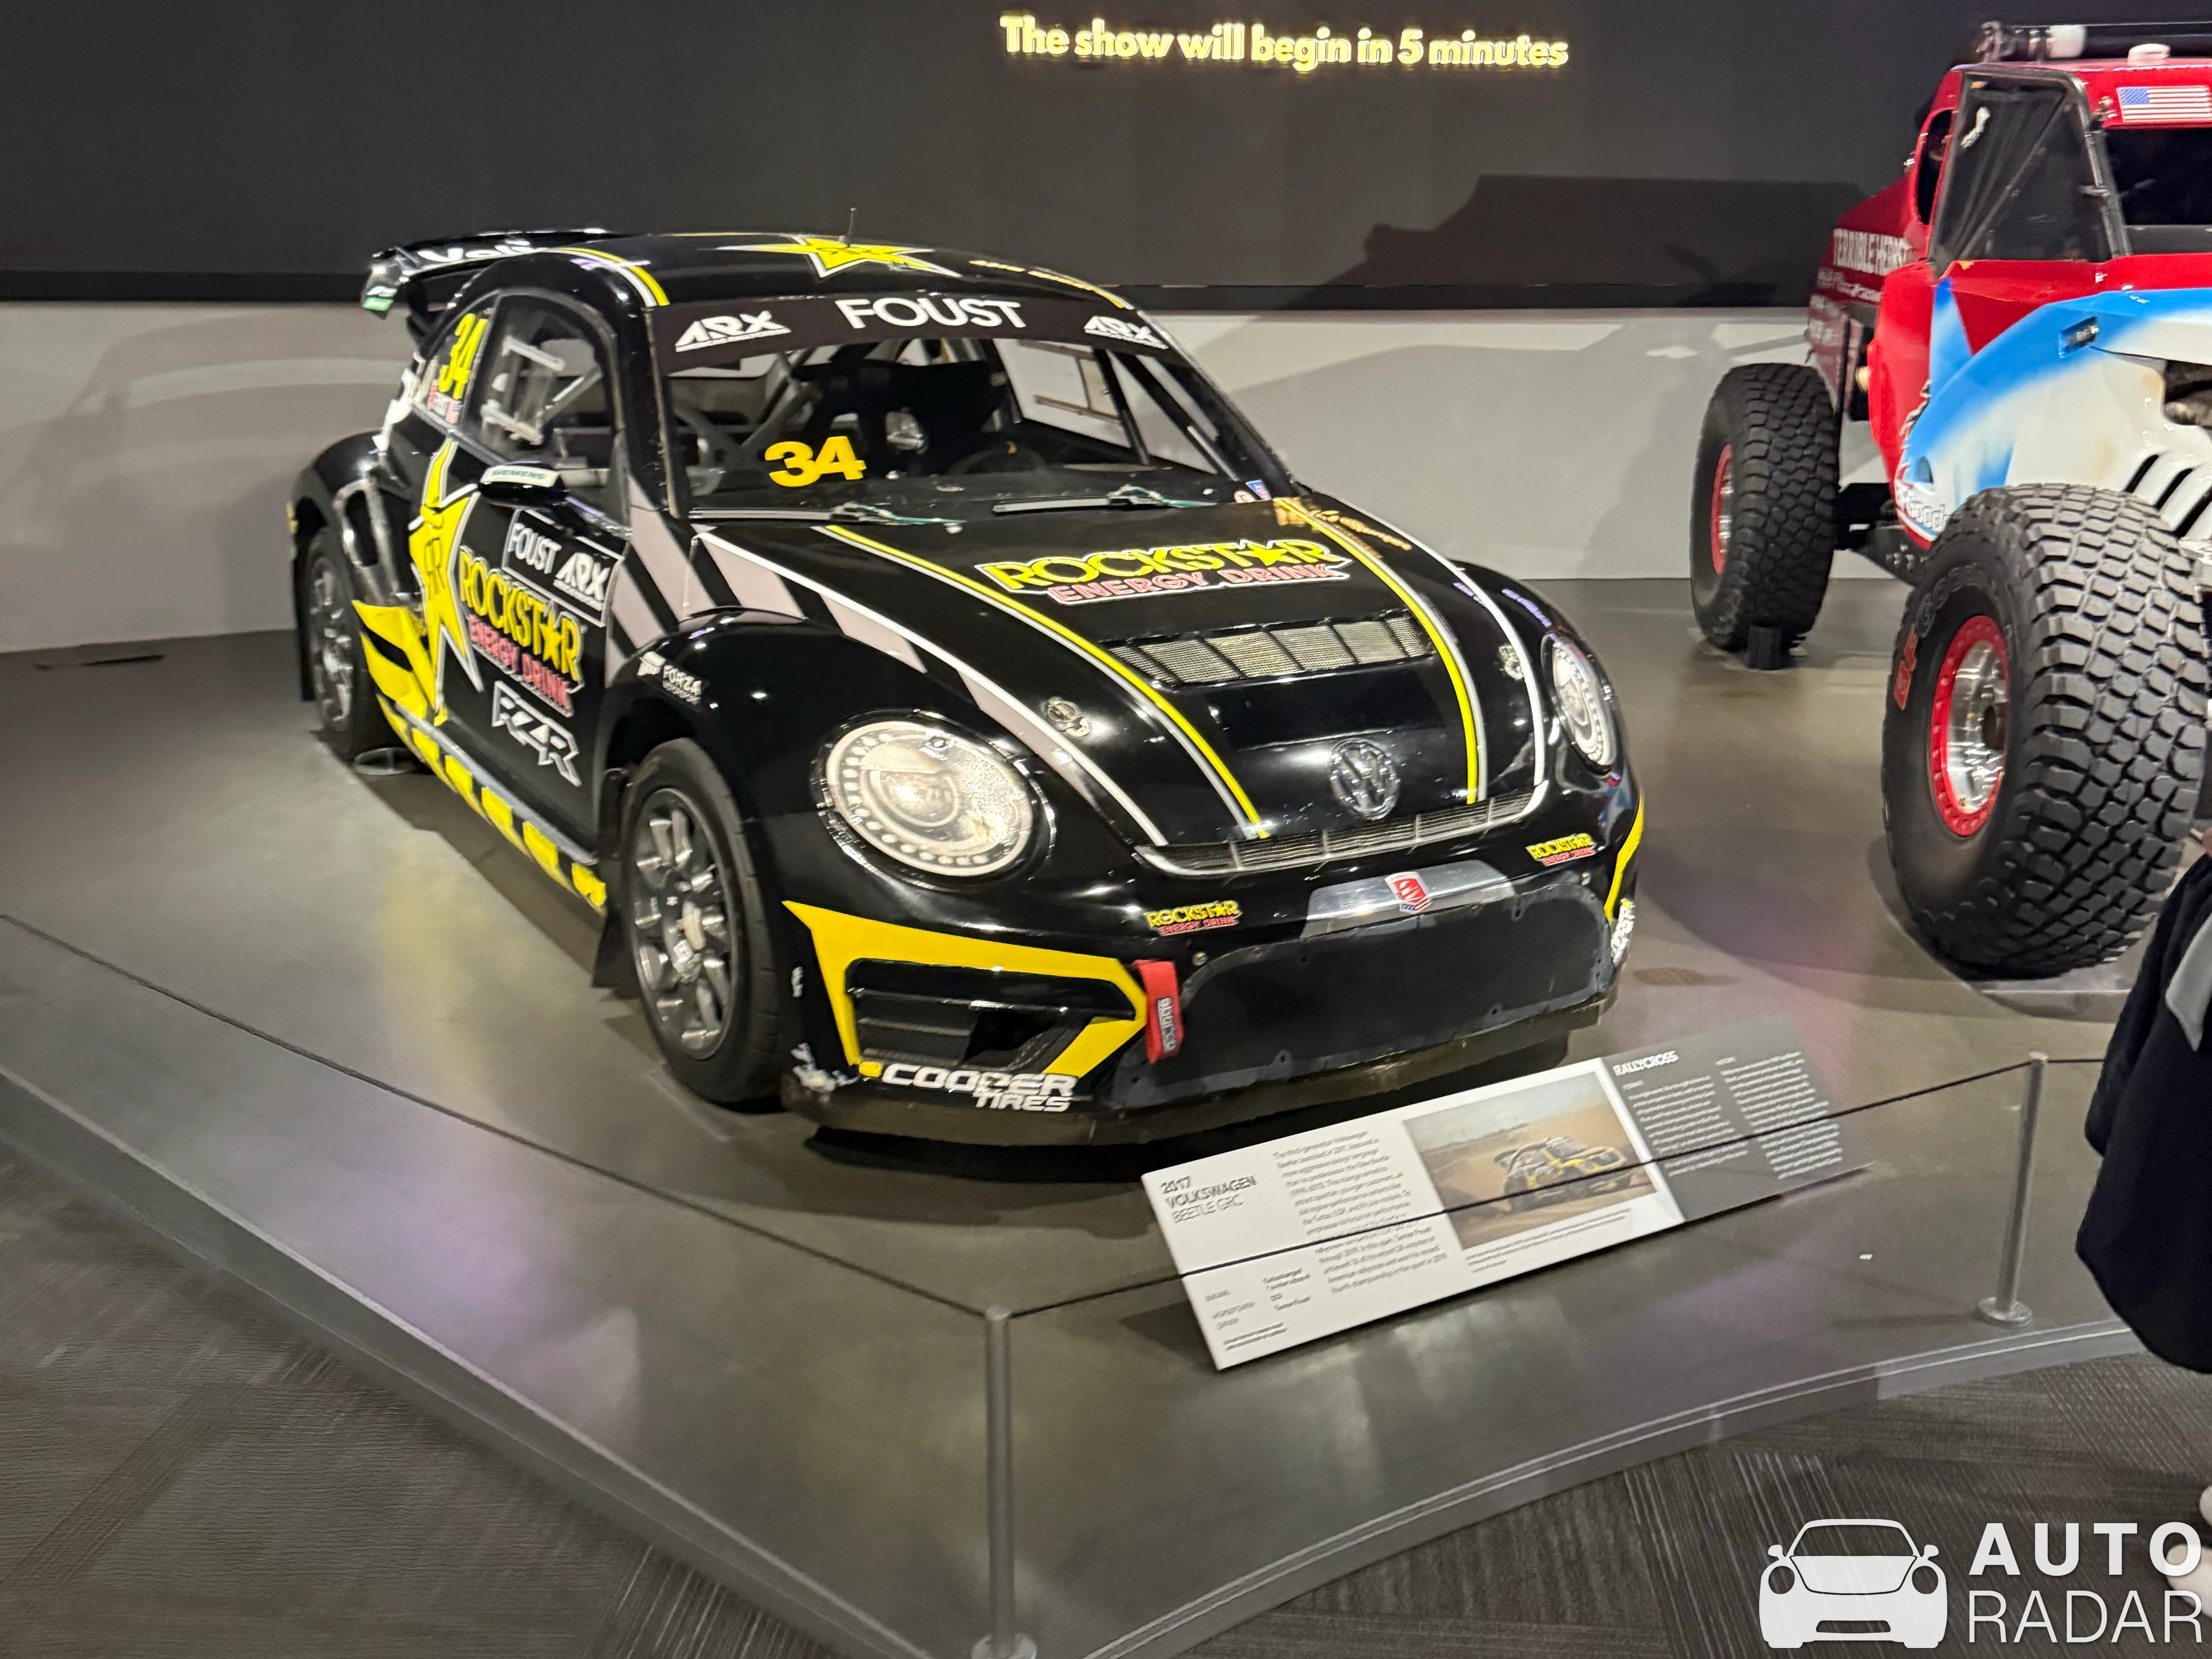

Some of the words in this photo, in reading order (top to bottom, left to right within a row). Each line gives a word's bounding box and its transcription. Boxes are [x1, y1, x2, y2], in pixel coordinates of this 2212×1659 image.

[1000, 14, 1070, 55] The
[1074, 18, 1175, 59] show
[1177, 22, 1245, 62] will
[1251, 23, 1352, 72] begin
[1357, 27, 1393, 65] in
[1397, 28, 1424, 65] 5
[1429, 29, 1569, 67] minutes
[835, 296, 1026, 328] FOUST
[438, 312, 488, 400] 34
[764, 435, 867, 487] 34
[507, 523, 562, 574] FOUST
[1049, 571, 1209, 601] ENERGY
[1218, 564, 1339, 584] DRINK
[881, 1063, 1078, 1097] COOPER
[1613, 1050, 1679, 1077] RALLYCROSS
[973, 1093, 1071, 1112] TIRES
[1160, 1175, 1192, 1194] 2017
[1165, 1175, 1257, 1208] VOLKSWAGEN
[1171, 1200, 1216, 1224] BEETLE
